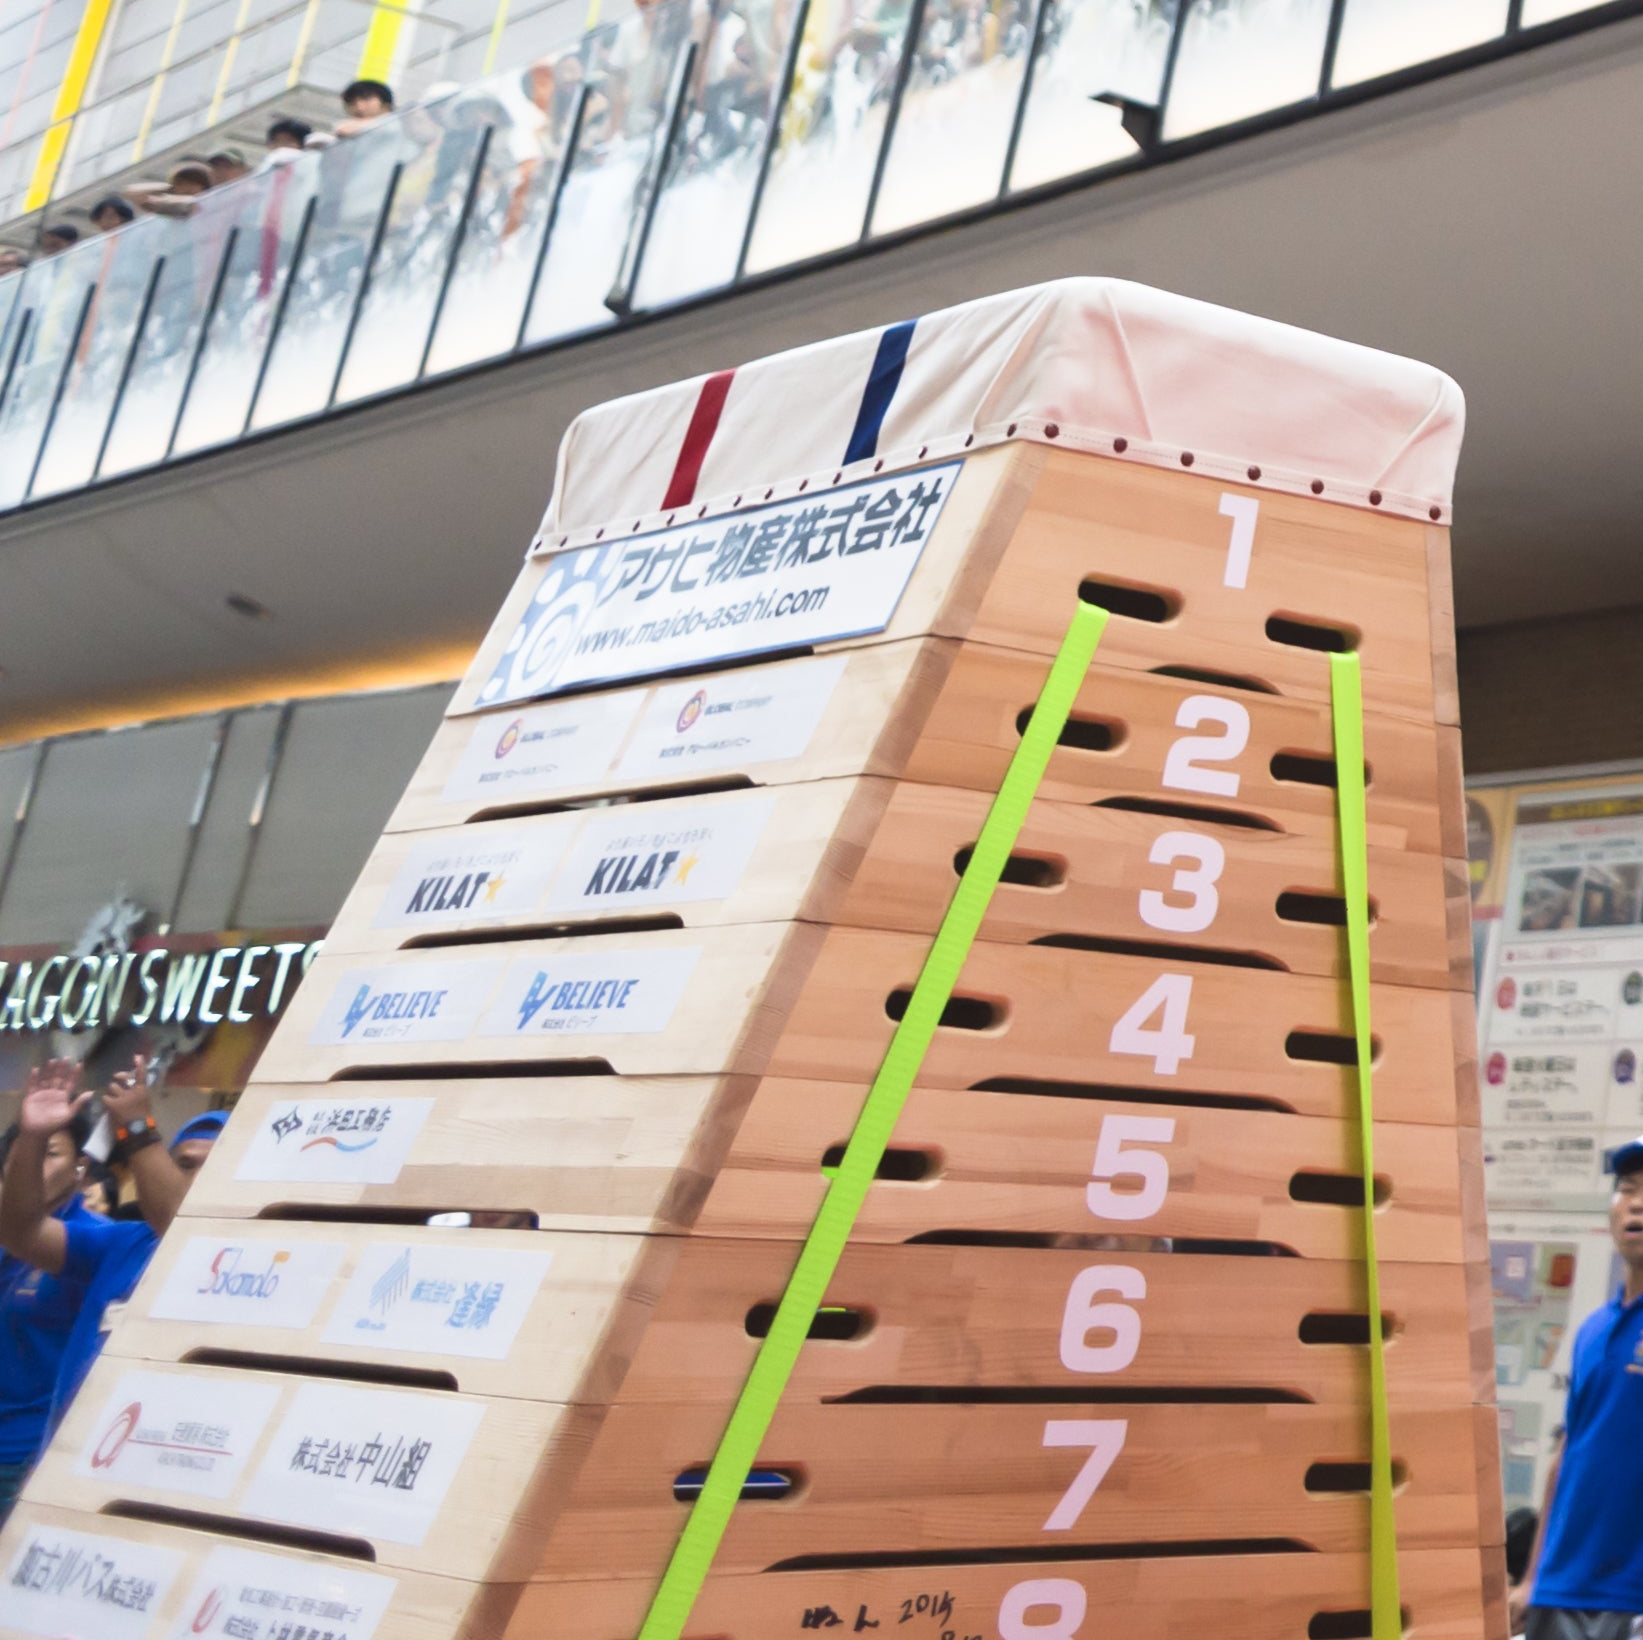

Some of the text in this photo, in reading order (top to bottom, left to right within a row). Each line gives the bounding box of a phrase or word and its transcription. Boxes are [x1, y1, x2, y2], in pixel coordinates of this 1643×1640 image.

[620, 477, 943, 602] アサヒ物産株式会社
[1218, 492, 1260, 590] 1
[576, 585, 830, 656] www.maido-asahi.com
[1162, 695, 1251, 798] 2
[405, 871, 491, 916] KILAT
[583, 850, 681, 897] KILAT
[1138, 831, 1226, 933] 3
[0, 954, 137, 1029] AGON
[371, 990, 449, 1021] BELIEVE
[550, 979, 641, 1011] BELIEVE
[1108, 972, 1196, 1076] 4
[1085, 1113, 1176, 1221] 5
[1058, 1264, 1147, 1374] 6
[1041, 1418, 1129, 1531] 7
